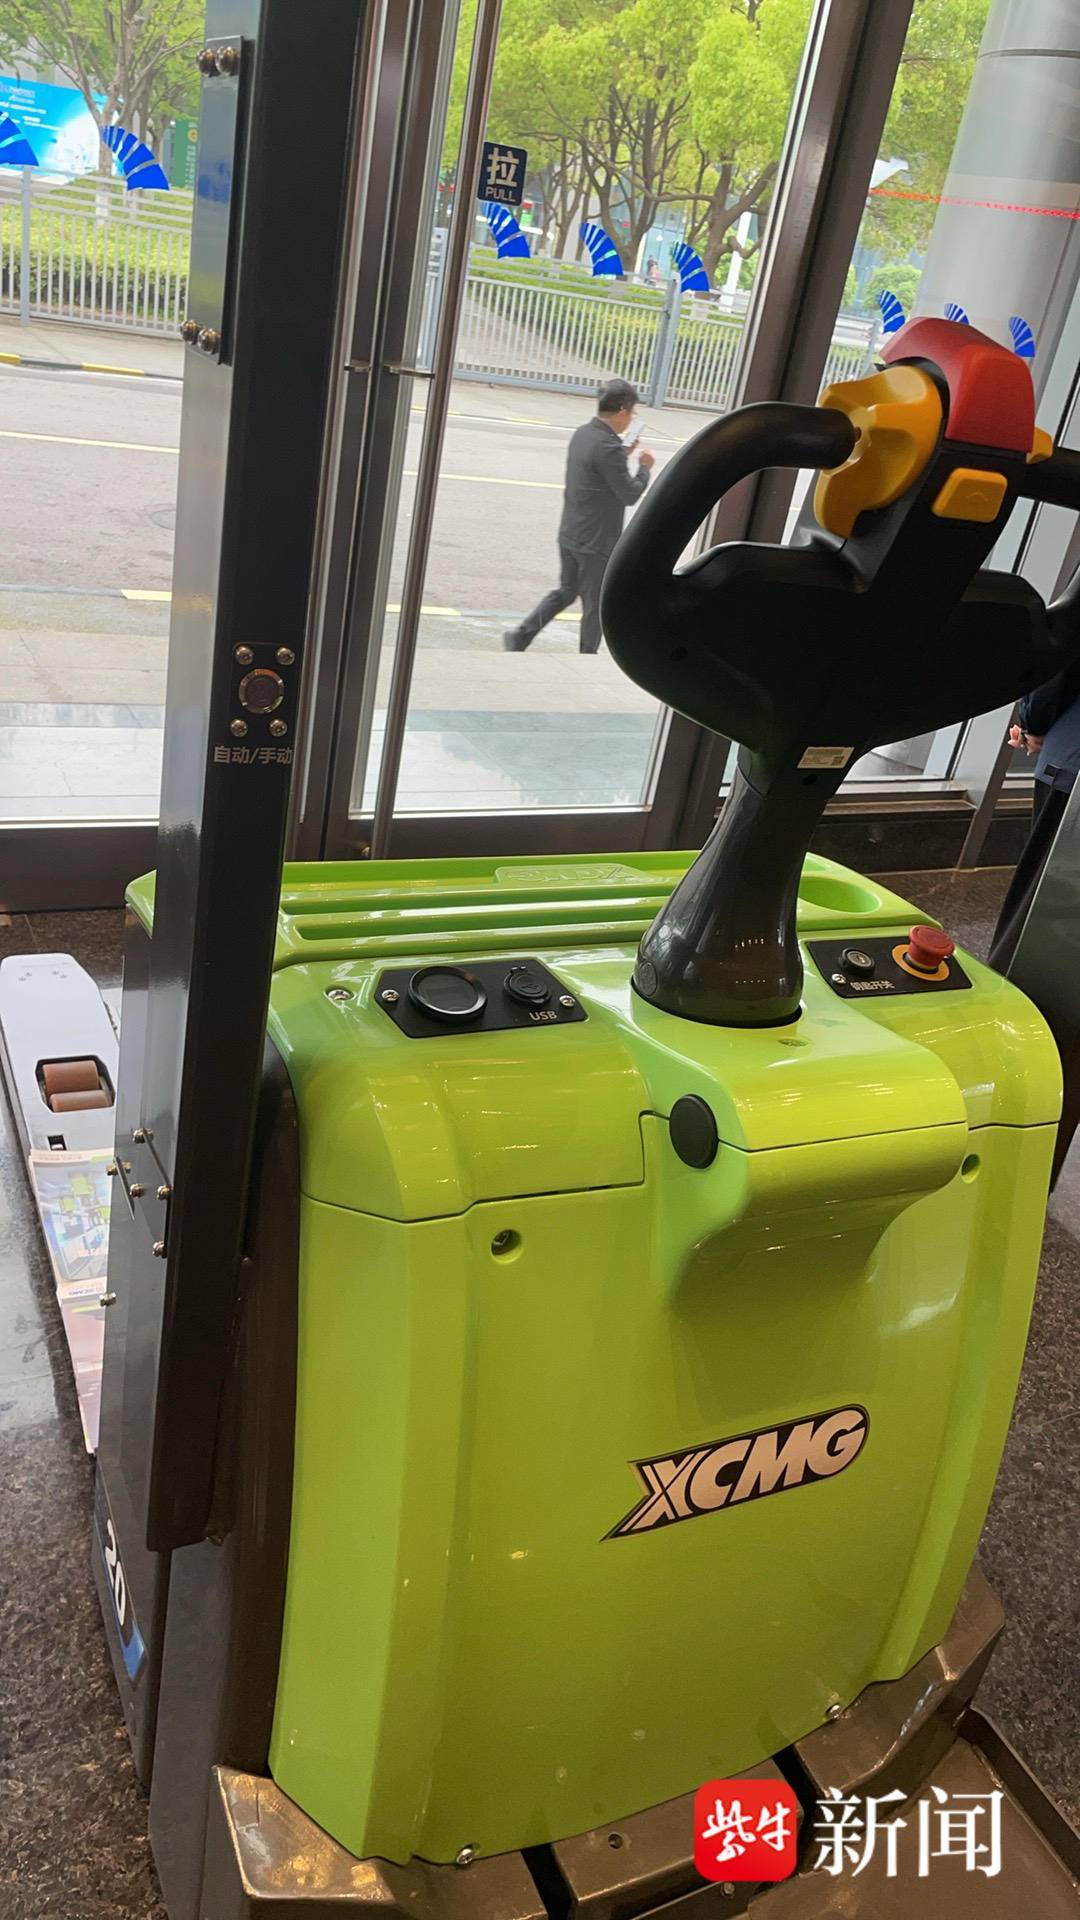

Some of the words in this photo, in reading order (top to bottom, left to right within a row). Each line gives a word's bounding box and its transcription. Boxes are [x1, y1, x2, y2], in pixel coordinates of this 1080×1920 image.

[487, 147, 519, 187] 拉
[485, 186, 516, 202] PULL
[213, 745, 294, 764] 自动/手动
[529, 1010, 558, 1021] USB
[618, 1409, 866, 1533] XCMG
